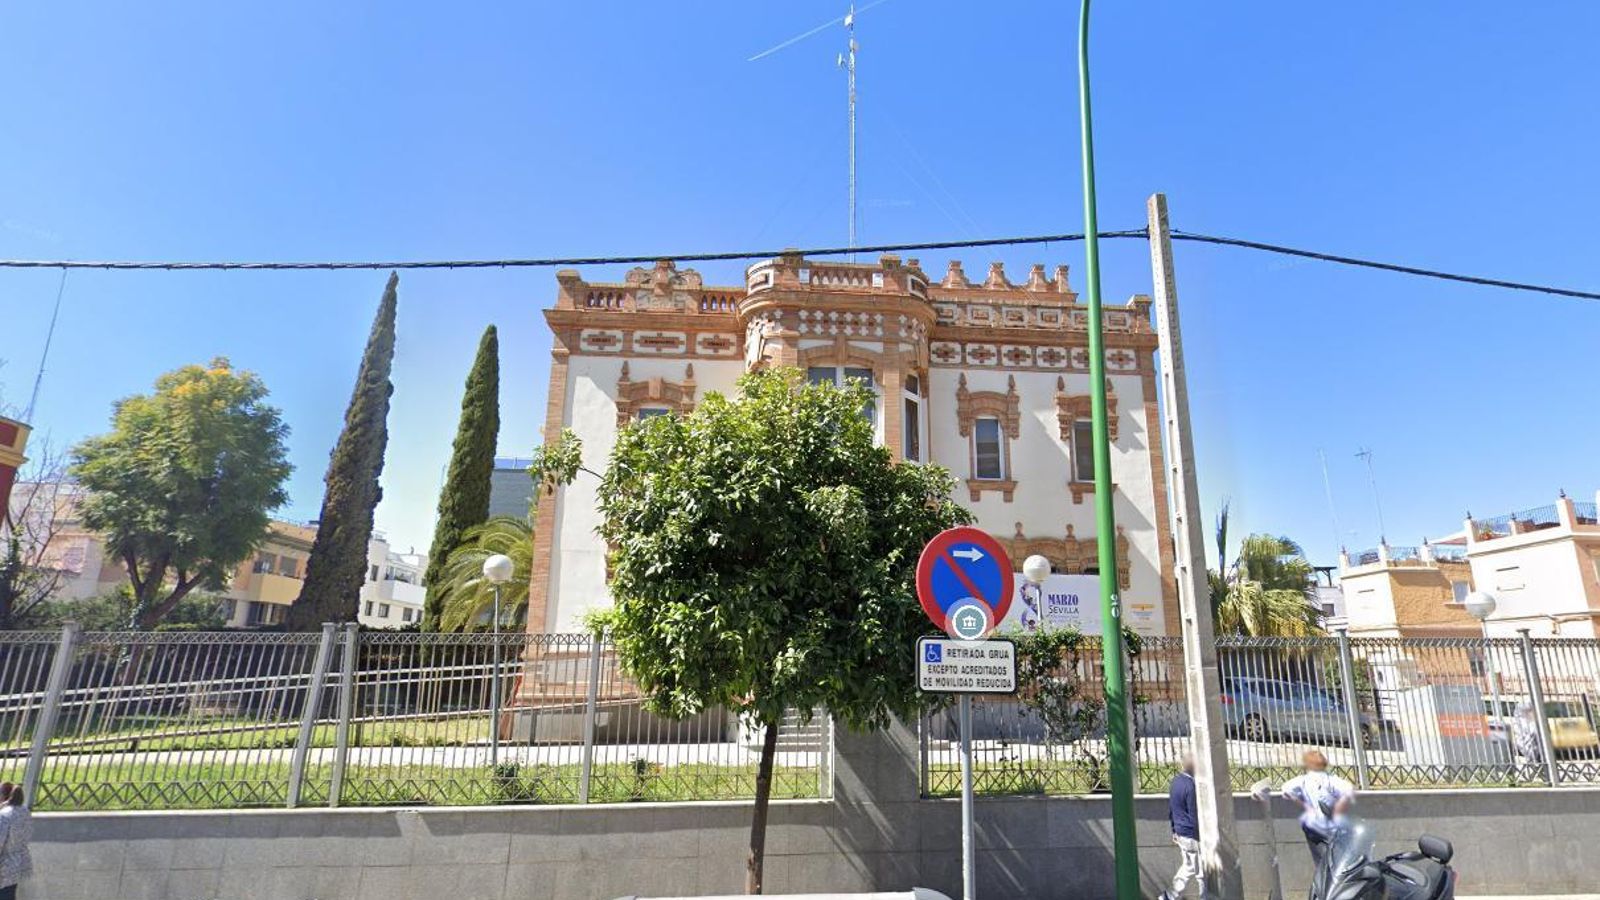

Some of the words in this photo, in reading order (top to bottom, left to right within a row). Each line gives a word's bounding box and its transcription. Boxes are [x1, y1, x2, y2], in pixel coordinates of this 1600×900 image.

[1047, 594, 1079, 606] MARZO
[1048, 606, 1079, 614] SEVILLA
[946, 648, 986, 659] RETIRADA
[988, 649, 1009, 659] GRUA
[927, 664, 958, 675] EXCEPTO
[961, 665, 1007, 676] ACREDITADOS
[923, 677, 933, 687] DE
[935, 677, 974, 688] MOVILIDAD
[976, 678, 1012, 688] REDUCIDA
